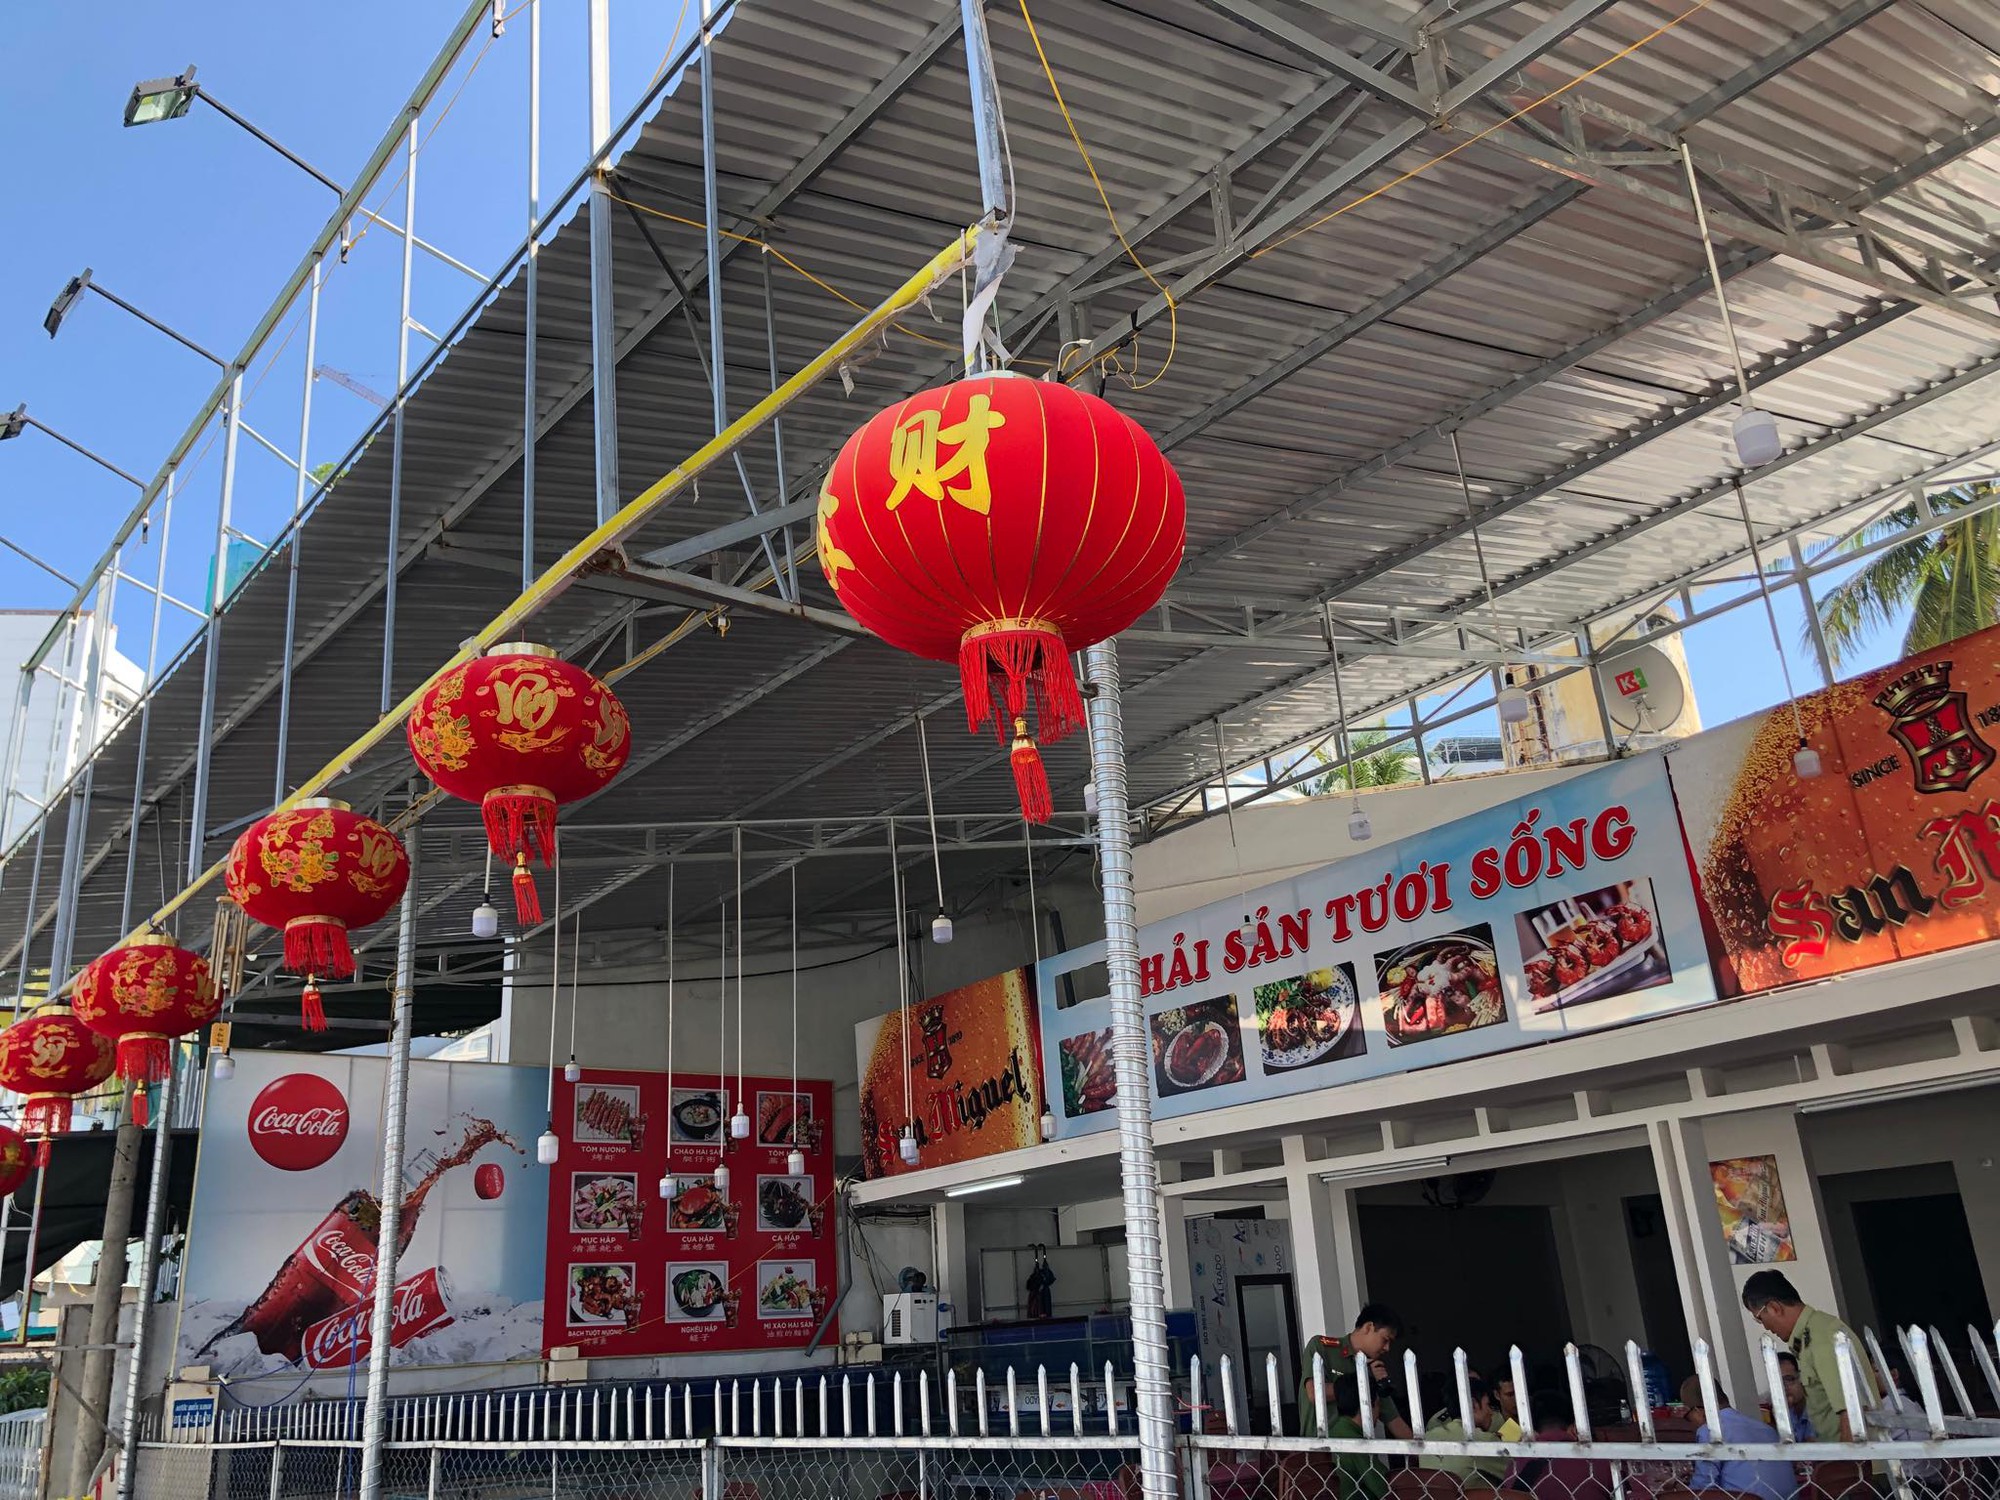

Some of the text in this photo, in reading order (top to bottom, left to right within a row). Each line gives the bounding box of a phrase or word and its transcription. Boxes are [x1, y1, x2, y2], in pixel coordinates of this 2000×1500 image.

[885, 393, 1006, 515] 财
[1849, 703, 2000, 788] SINCE 18
[1140, 805, 1638, 998] HẢI SẢN TƯƠI SỐNG
[1767, 863, 1937, 970] San
[253, 1106, 346, 1137] Coca-Cola
[681, 1236, 698, 1245] CUA
[313, 1275, 428, 1363] Coca-ola
